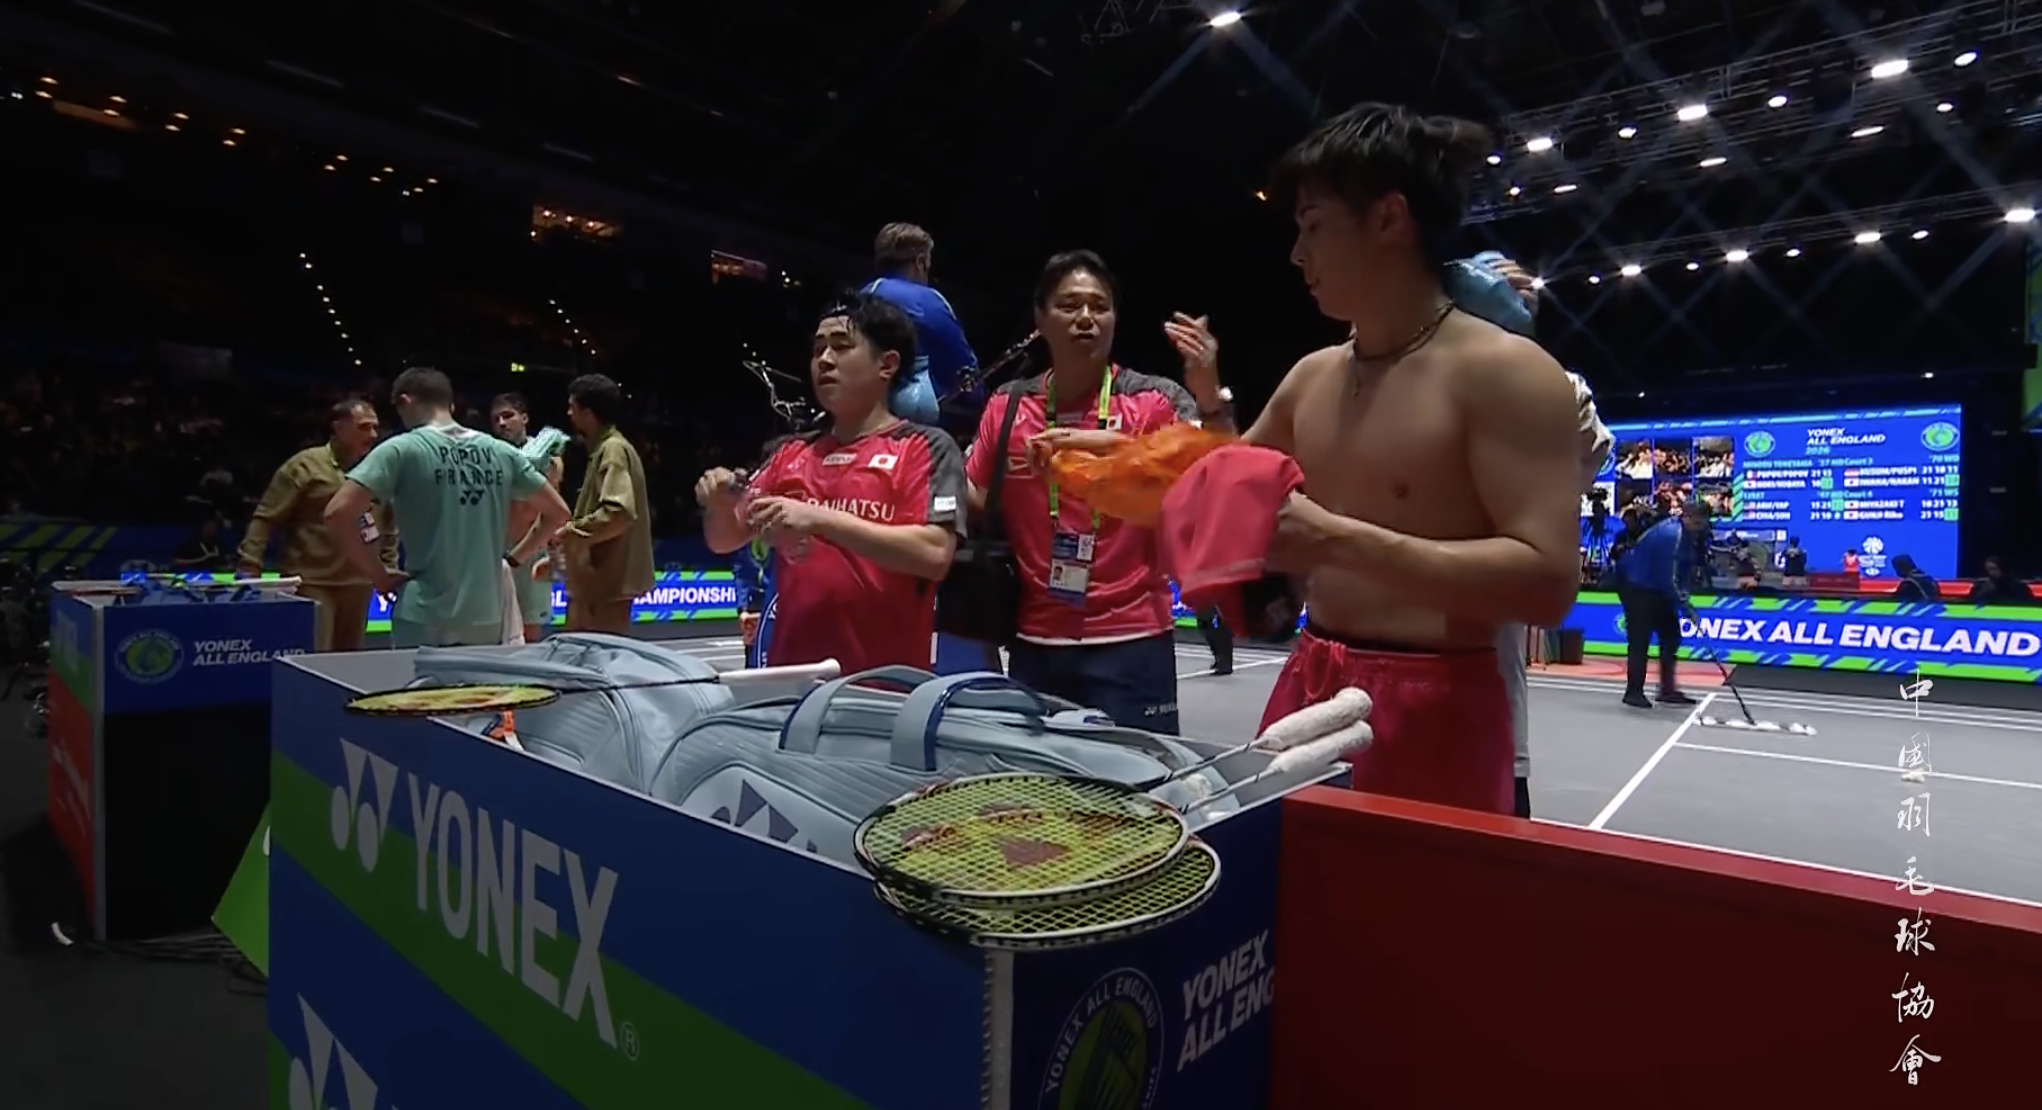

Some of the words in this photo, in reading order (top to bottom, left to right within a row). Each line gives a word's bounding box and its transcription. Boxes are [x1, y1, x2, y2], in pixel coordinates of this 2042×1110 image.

[1806, 427, 1846, 437] YONEX
[1806, 436, 1828, 446] ALL
[1830, 434, 1886, 445] ENGLAND
[439, 445, 492, 465] POPOV
[434, 468, 503, 486] FRANCE
[193, 639, 253, 653] YONEX
[1679, 617, 1767, 642] ONEX
[1767, 620, 1834, 645] ALL
[1839, 623, 2041, 656] ENGLAND
[192, 652, 225, 667] ALL
[408, 772, 618, 1049] YONEX
[1182, 928, 1269, 1021] YONEX
[1045, 1015, 1084, 1094] YONEX
[1086, 981, 1111, 1016] ALL
[1115, 976, 1158, 1028] ENGLAND
[1176, 1002, 1227, 1073] ALL
